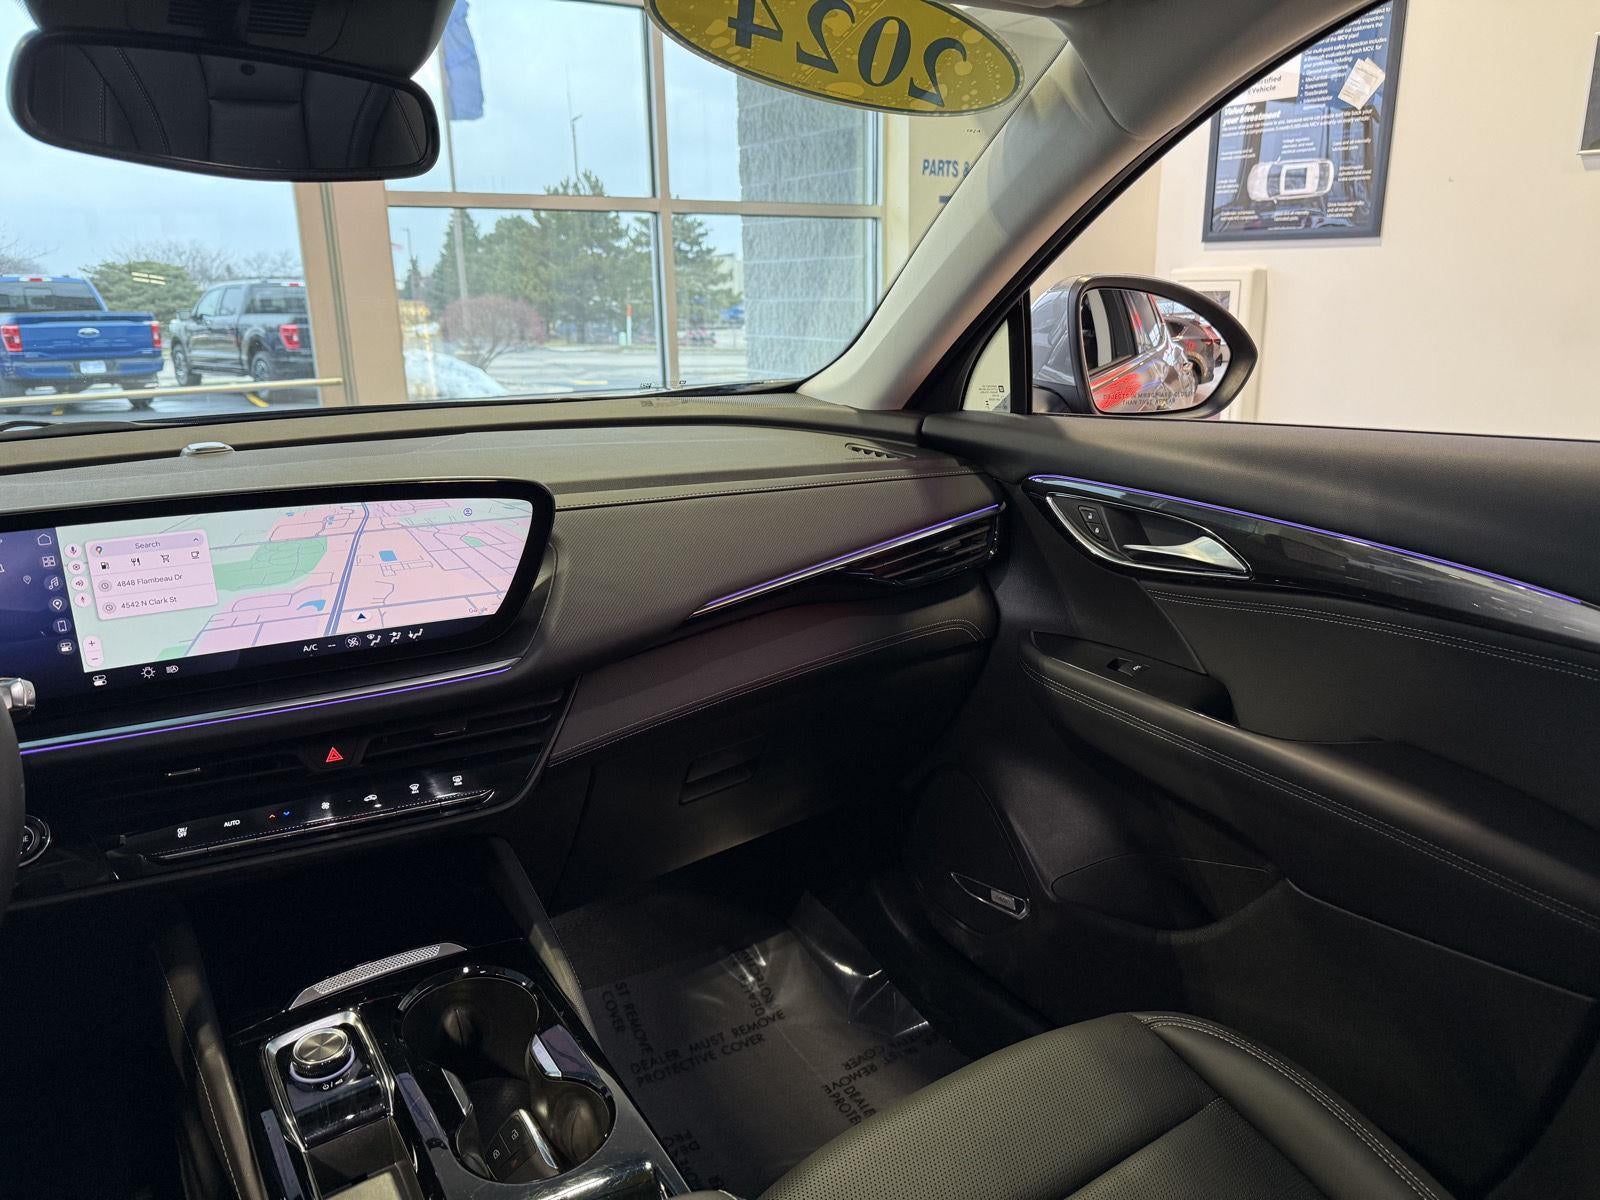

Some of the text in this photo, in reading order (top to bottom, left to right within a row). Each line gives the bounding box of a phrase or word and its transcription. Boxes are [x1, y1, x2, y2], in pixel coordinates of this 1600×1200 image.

[1251, 85, 1276, 94] Vehicle
[922, 158, 959, 178] PARTS
[134, 540, 161, 550] Search
[116, 580, 136, 588] 4848
[137, 576, 173, 587] Flambeau
[120, 596, 177, 610] 4542 N Clark St
[303, 643, 318, 652] A/C
[223, 819, 241, 828] AUTO
[601, 990, 626, 1033] COVER
[623, 1002, 654, 1055] REMOVE
[629, 1008, 785, 1075] DEALER MUST REMOVE
[636, 1032, 767, 1088] PROTECTIVE COVER
[823, 1063, 878, 1095] REMOVE
